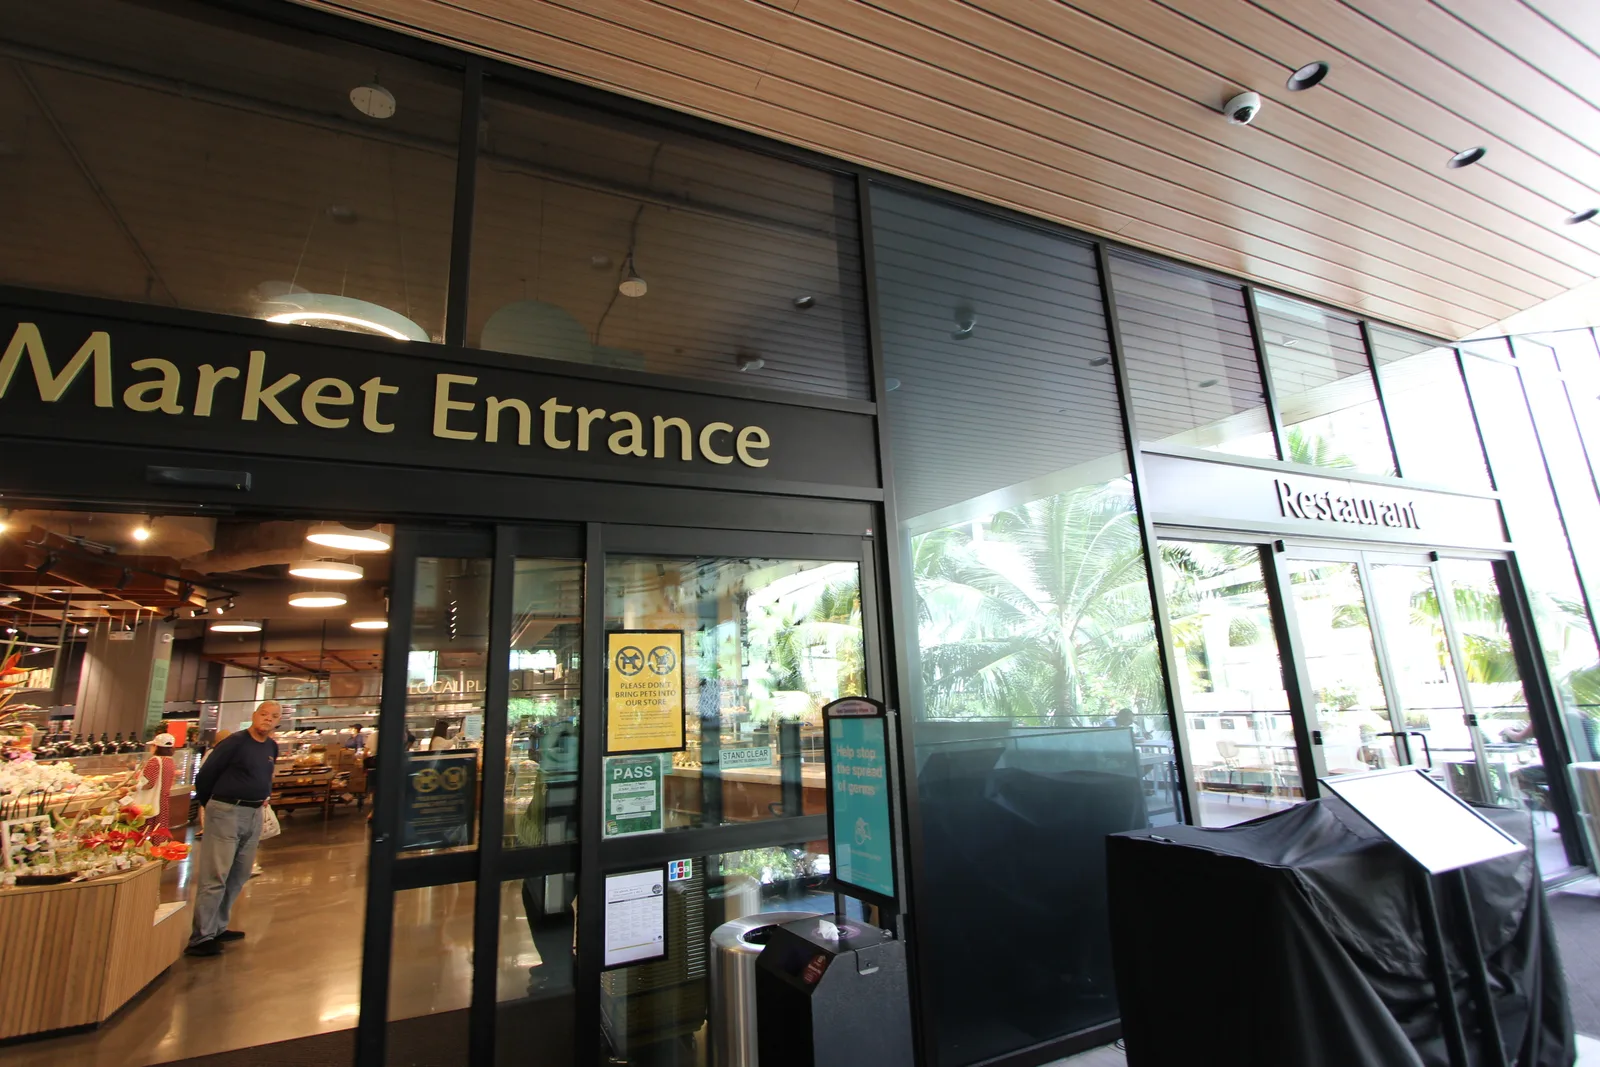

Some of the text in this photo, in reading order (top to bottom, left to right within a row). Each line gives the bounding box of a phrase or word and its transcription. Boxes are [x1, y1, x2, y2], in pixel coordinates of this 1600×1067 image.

[0, 322, 770, 468] Market Entrance
[1274, 479, 1420, 530] Restaurant
[408, 679, 461, 695] LOCAL
[648, 681, 671, 689] DON'T
[640, 690, 657, 698] PETS
[643, 698, 667, 706] STORE
[723, 749, 768, 760] STAND CLEAR
[835, 744, 877, 761] Help stop
[613, 765, 653, 780] PASS
[837, 762, 883, 778] the spread
[837, 780, 876, 796] of germs
